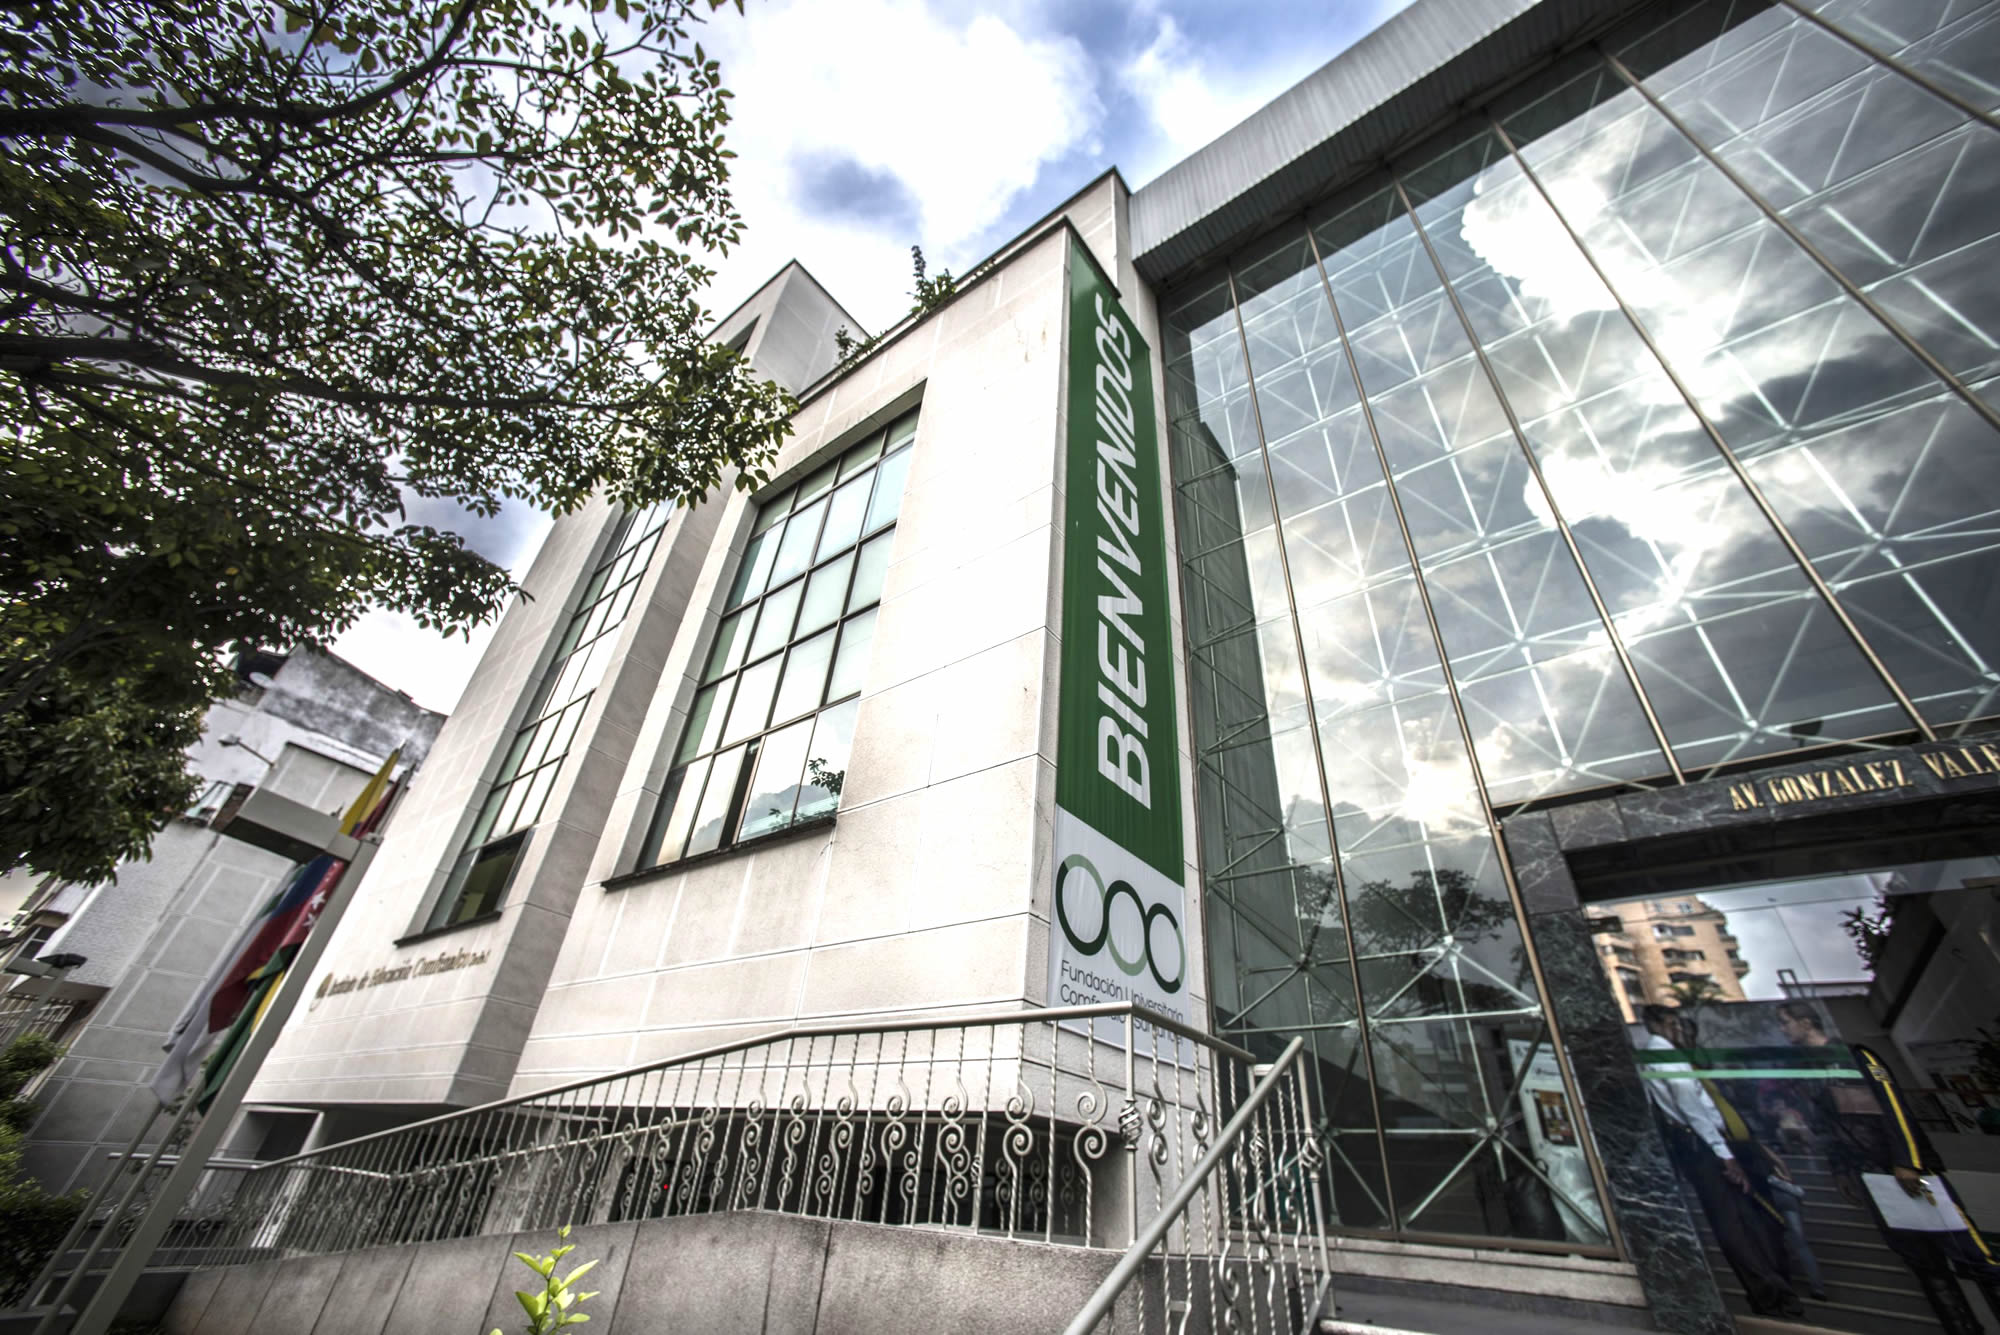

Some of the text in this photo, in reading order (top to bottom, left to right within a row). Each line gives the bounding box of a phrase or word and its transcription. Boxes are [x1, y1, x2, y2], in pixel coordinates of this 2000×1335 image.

[1096, 292, 1151, 810] BIENVENIDOS
[1728, 782, 1764, 811] AV.
[1767, 759, 1913, 804] GONZALEZ
[1060, 959, 1123, 1000] Fundación
